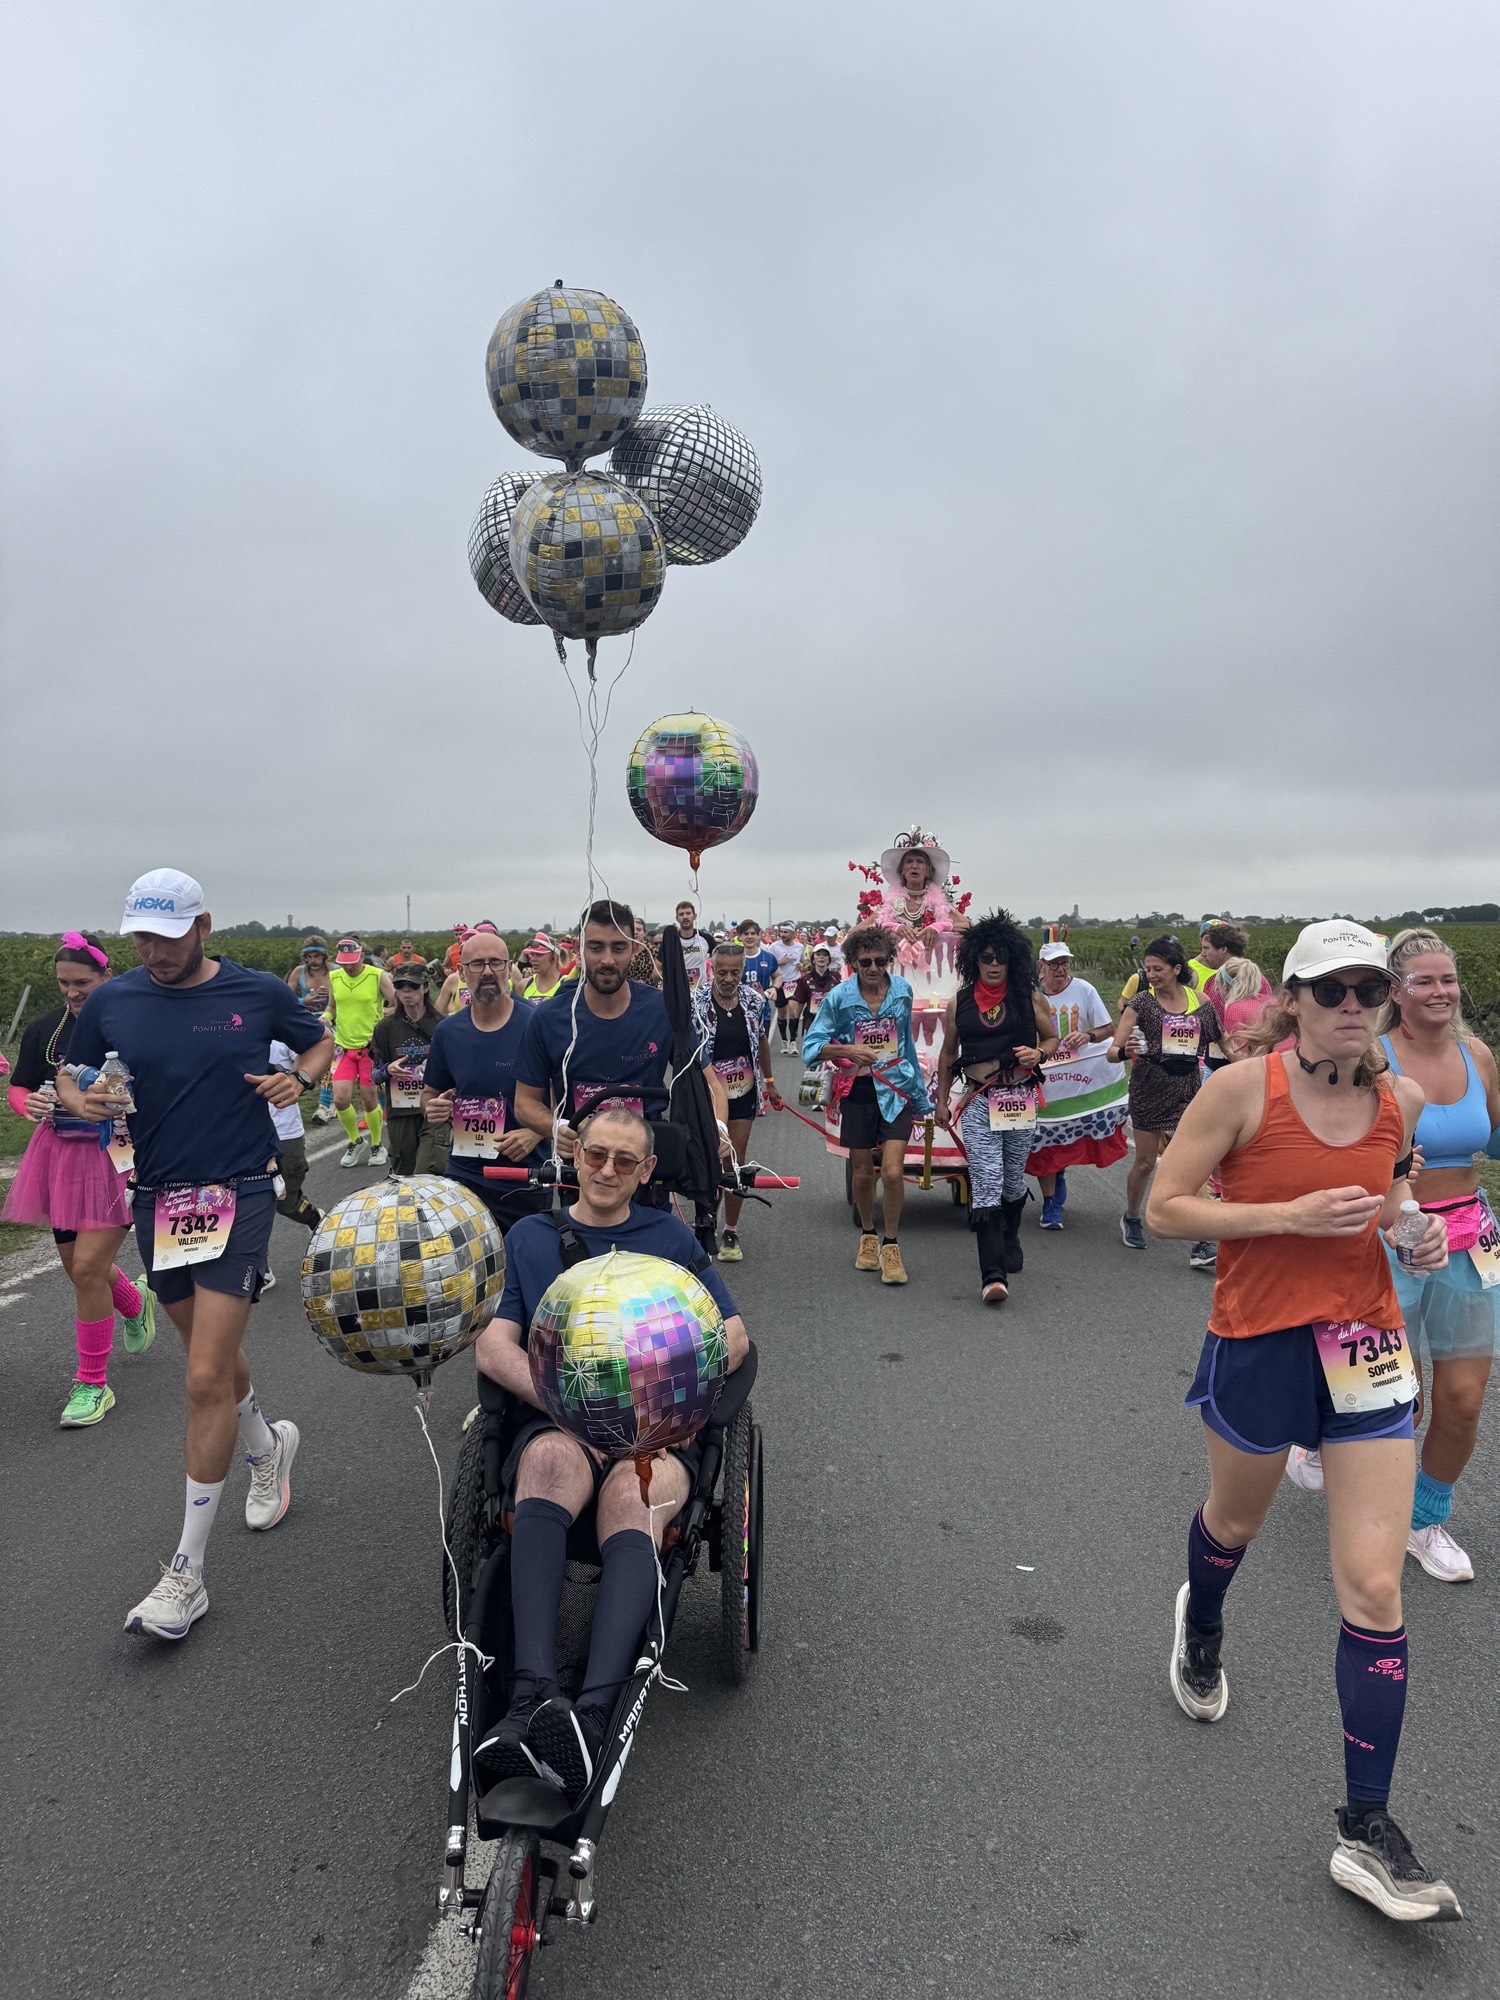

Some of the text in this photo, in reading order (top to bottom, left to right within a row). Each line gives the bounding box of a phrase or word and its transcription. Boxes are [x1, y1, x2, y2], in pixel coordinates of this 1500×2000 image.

[133, 897, 175, 912] HOKA
[745, 970, 757, 982] 18
[862, 1033, 890, 1045] 2054
[1170, 1028, 1195, 1039] 2056
[1048, 1051, 1072, 1061] 053
[726, 1071, 745, 1084] 978
[1049, 1072, 1093, 1085] BIRTHDAY
[397, 1080, 425, 1091] 9595
[997, 1100, 1027, 1112] 2055
[462, 1118, 496, 1134] 7340
[475, 1133, 484, 1141] LÉA
[168, 1213, 220, 1236] 7342
[177, 1235, 209, 1247] VALENTIN
[242, 1265, 254, 1291] HOKA
[1337, 1327, 1350, 1341] du
[1340, 1329, 1403, 1368] 7343
[1367, 1358, 1401, 1378] SOPHIE
[1382, 1667, 1406, 1675] SPORT
